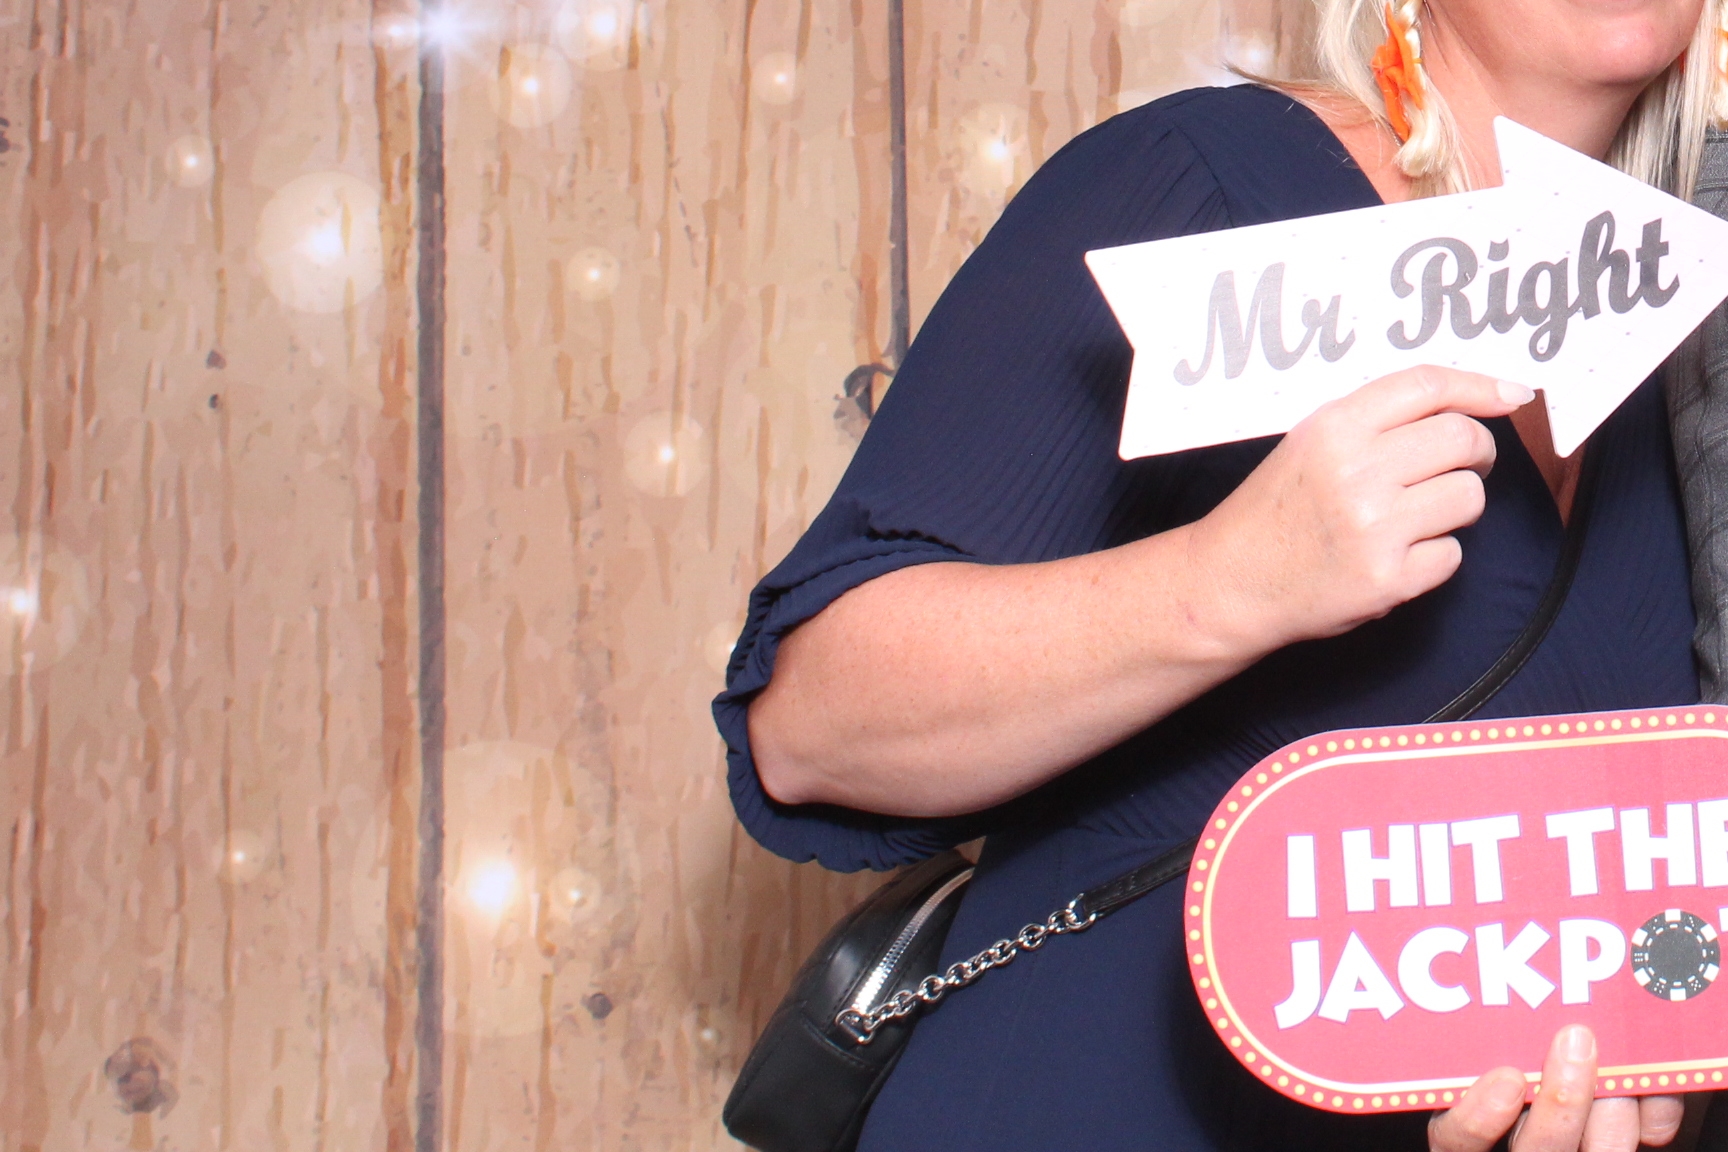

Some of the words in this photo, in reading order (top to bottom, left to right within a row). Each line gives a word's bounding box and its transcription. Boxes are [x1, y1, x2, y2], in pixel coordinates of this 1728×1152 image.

[1172, 262, 1356, 387] Mr
[1386, 210, 1680, 363] Right
[1286, 834, 1318, 919] I
[1341, 813, 1522, 913] HIT
